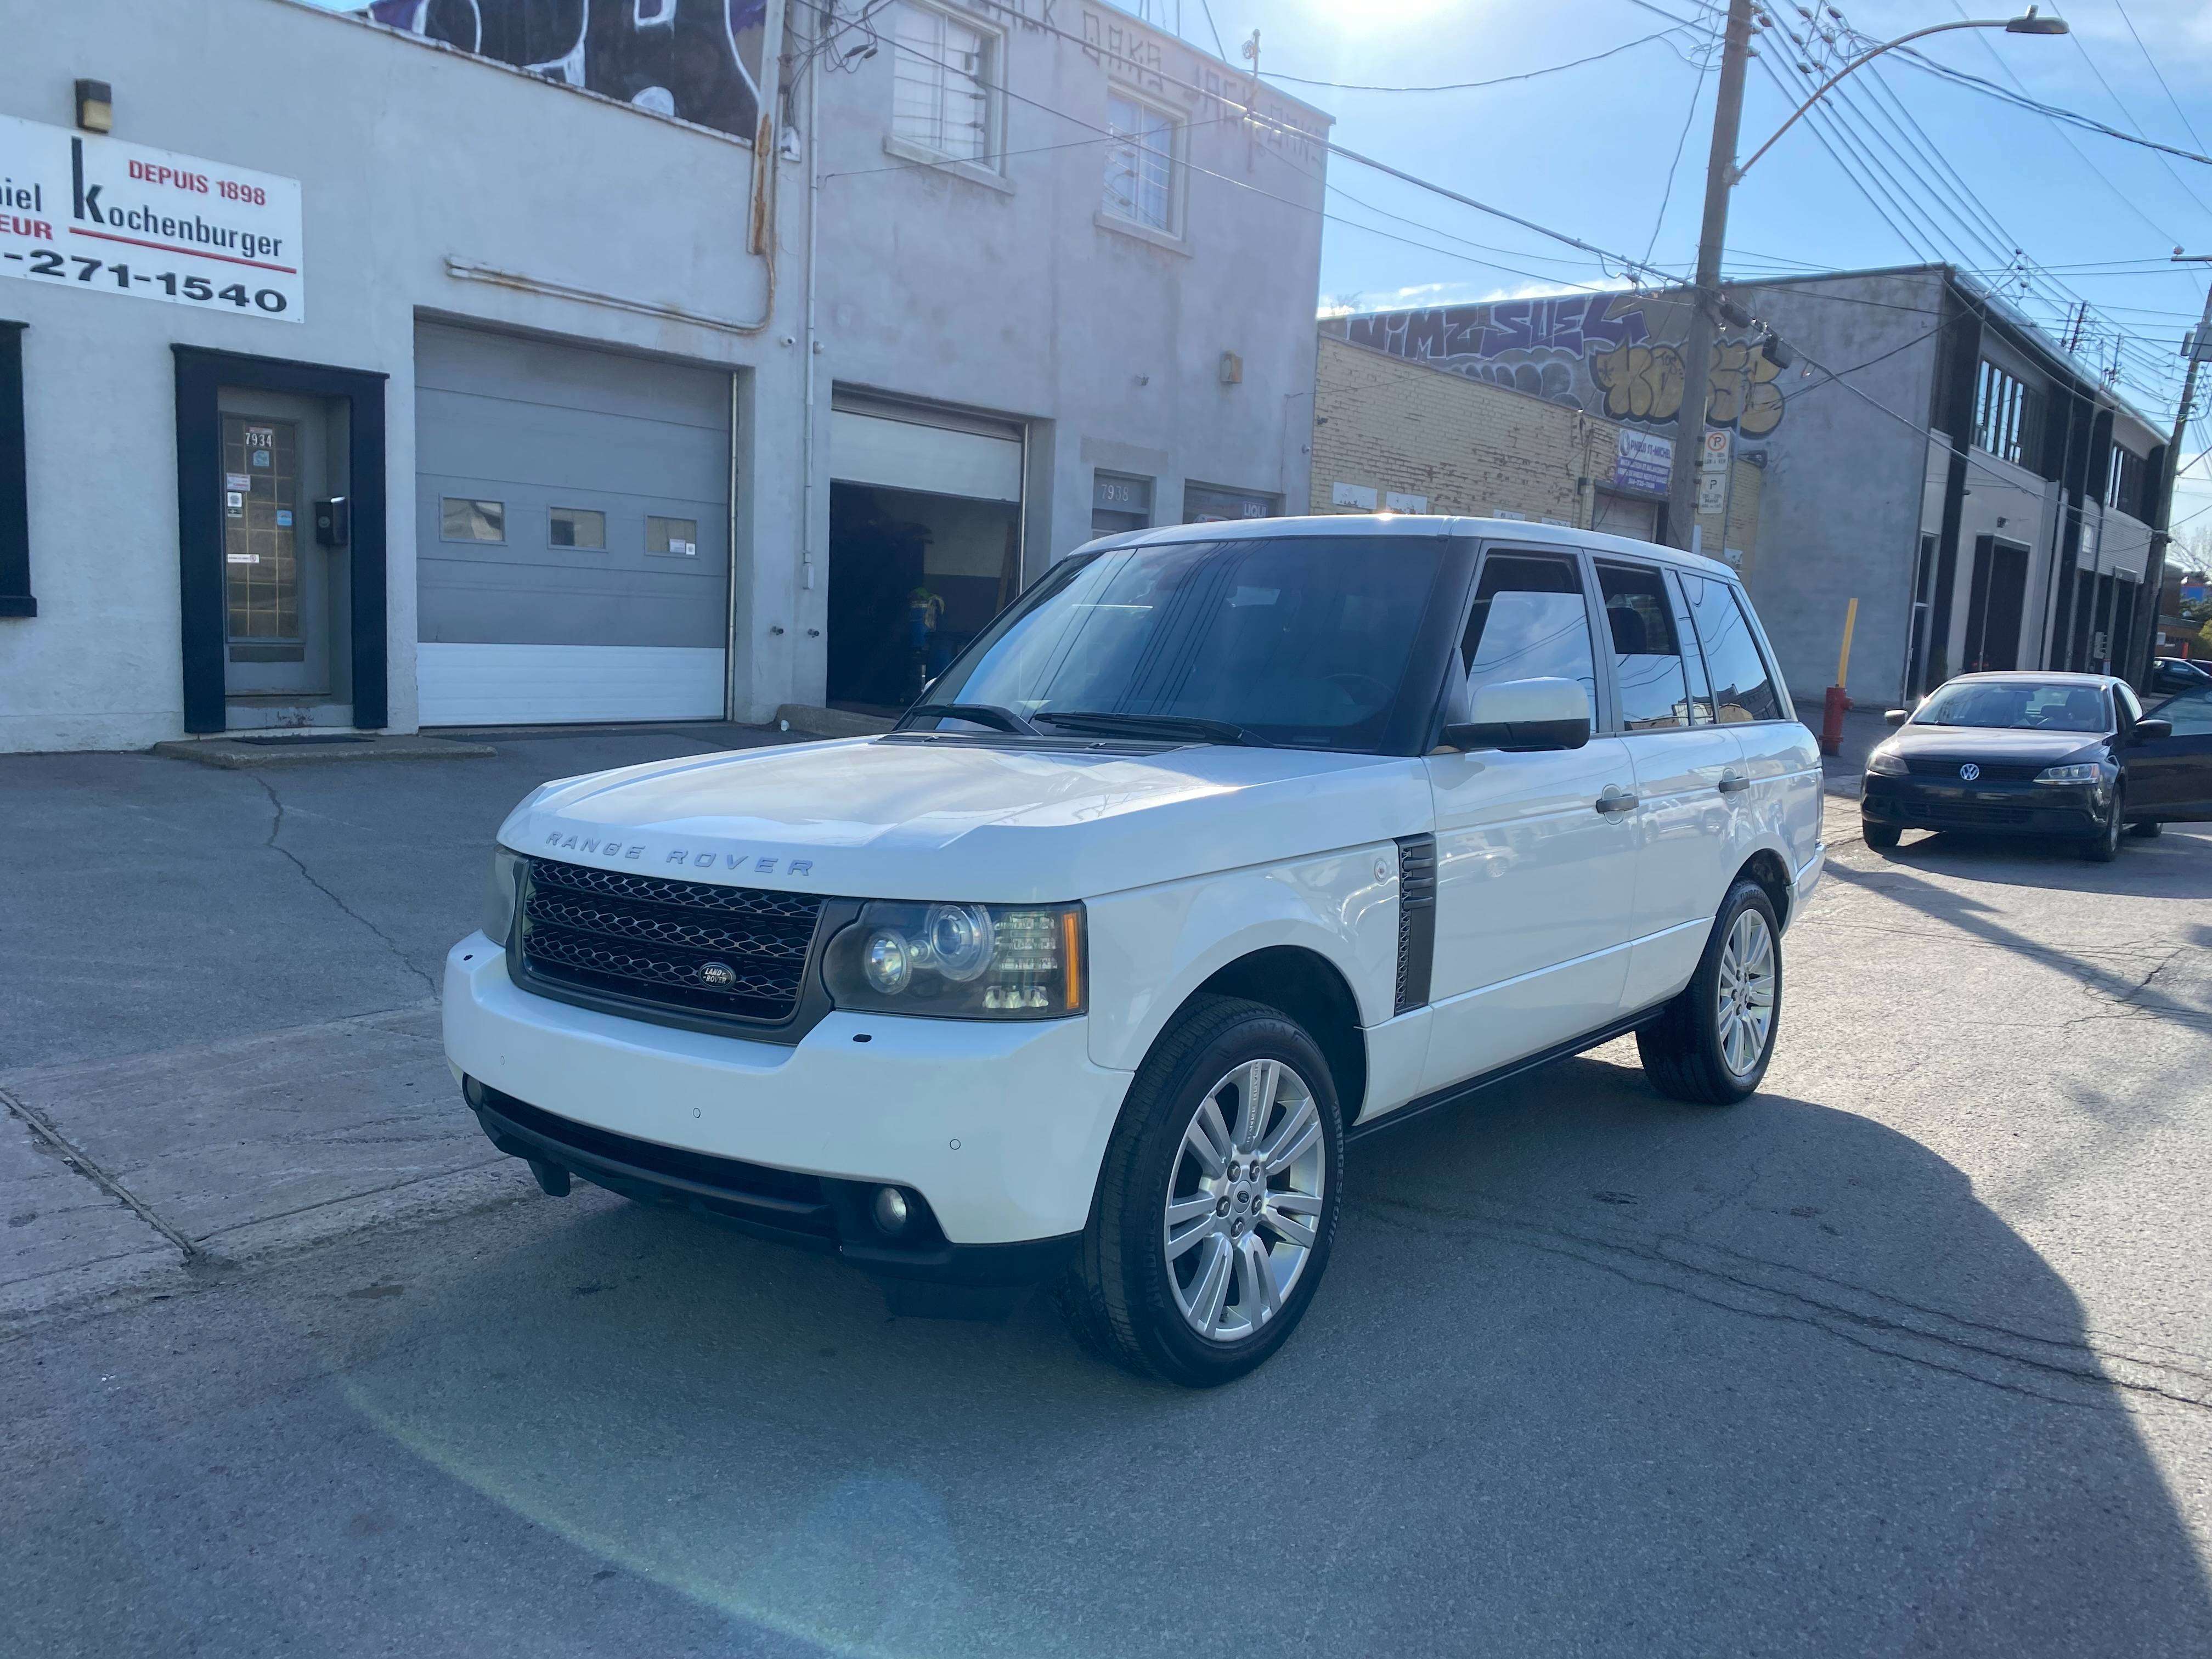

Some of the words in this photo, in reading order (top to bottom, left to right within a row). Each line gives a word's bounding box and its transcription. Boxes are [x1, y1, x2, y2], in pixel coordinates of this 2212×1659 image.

[0, 177, 42, 212] iel
[71, 136, 282, 258] Kochenburger
[128, 159, 208, 193] DEPUIS
[216, 180, 266, 206] 1898
[245, 432, 272, 447] 7934
[1101, 484, 1128, 502] 7938
[1709, 479, 1717, 490] P
[546, 831, 646, 859] RANGE
[666, 850, 814, 876] ROVER
